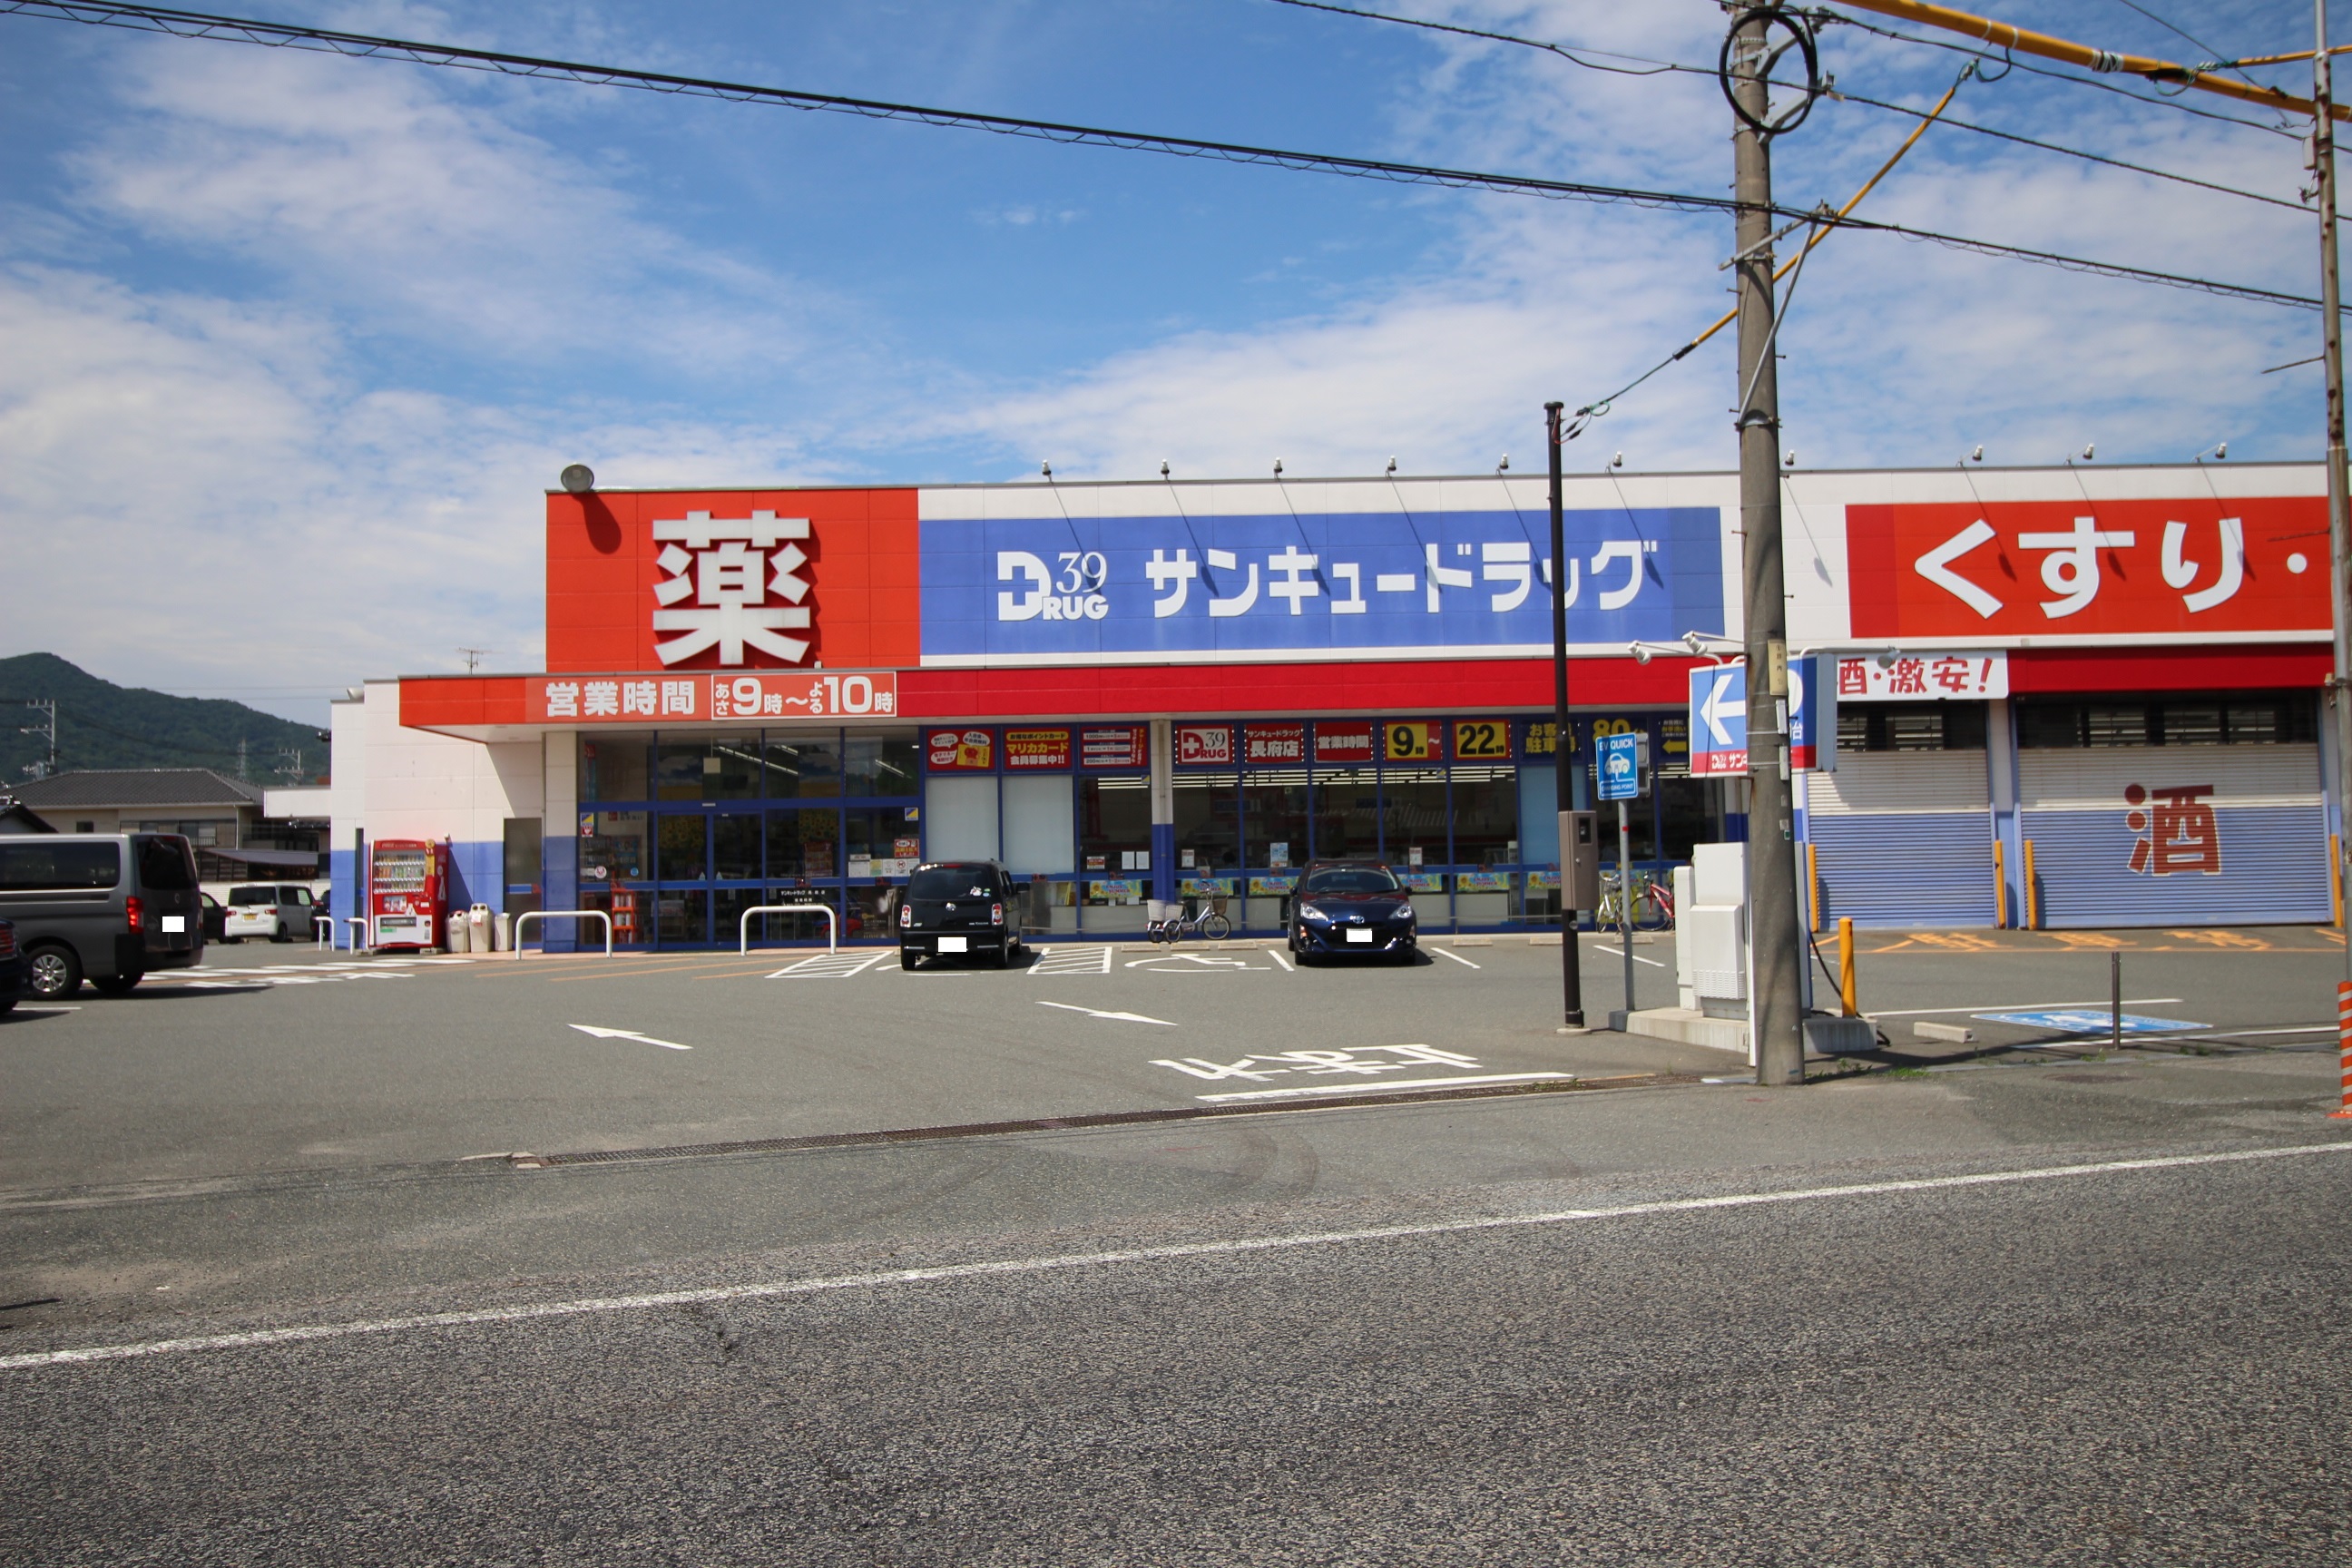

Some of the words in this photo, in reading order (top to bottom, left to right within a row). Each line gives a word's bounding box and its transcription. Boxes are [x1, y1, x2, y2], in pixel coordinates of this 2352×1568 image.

[1055, 552, 1107, 593] 39
[1145, 540, 1658, 619] サンキュードラッグ
[652, 510, 810, 665] 薬
[545, 681, 695, 717] 営業時間
[1247, 729, 1300, 739] サンキュードラッグ
[1529, 722, 1572, 737] お客
[1006, 742, 1069, 754] マリカカード
[1250, 740, 1299, 759] 長府店
[1317, 735, 1369, 750] 営業時間
[1599, 741, 1609, 752] EV
[1610, 738, 1633, 750] QUICK
[2124, 782, 2222, 877] 酒
